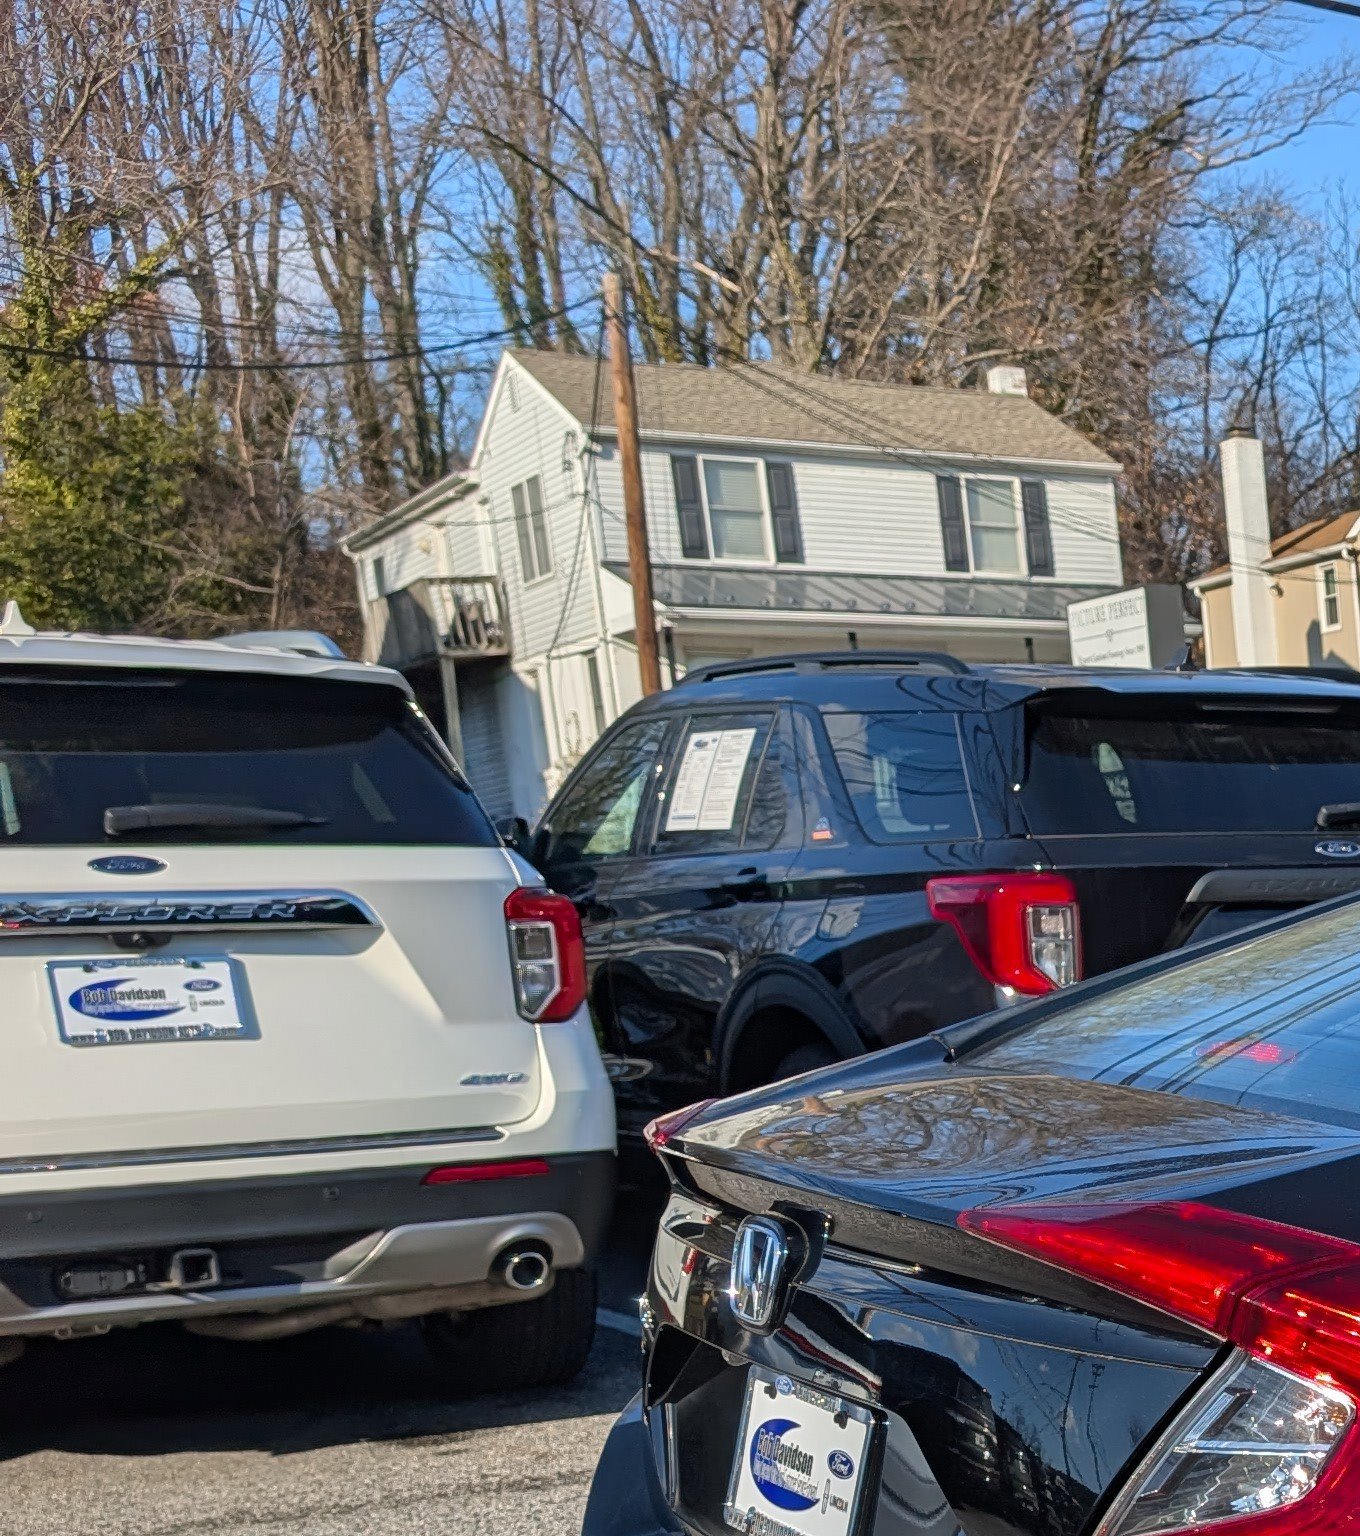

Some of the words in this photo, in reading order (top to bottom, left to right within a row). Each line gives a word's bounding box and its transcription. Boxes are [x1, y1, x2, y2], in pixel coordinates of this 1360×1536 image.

[82, 988, 107, 1005] Bob
[108, 986, 167, 1002] Davidson
[757, 1427, 775, 1459] Bob
[772, 1435, 814, 1477] Davidson
